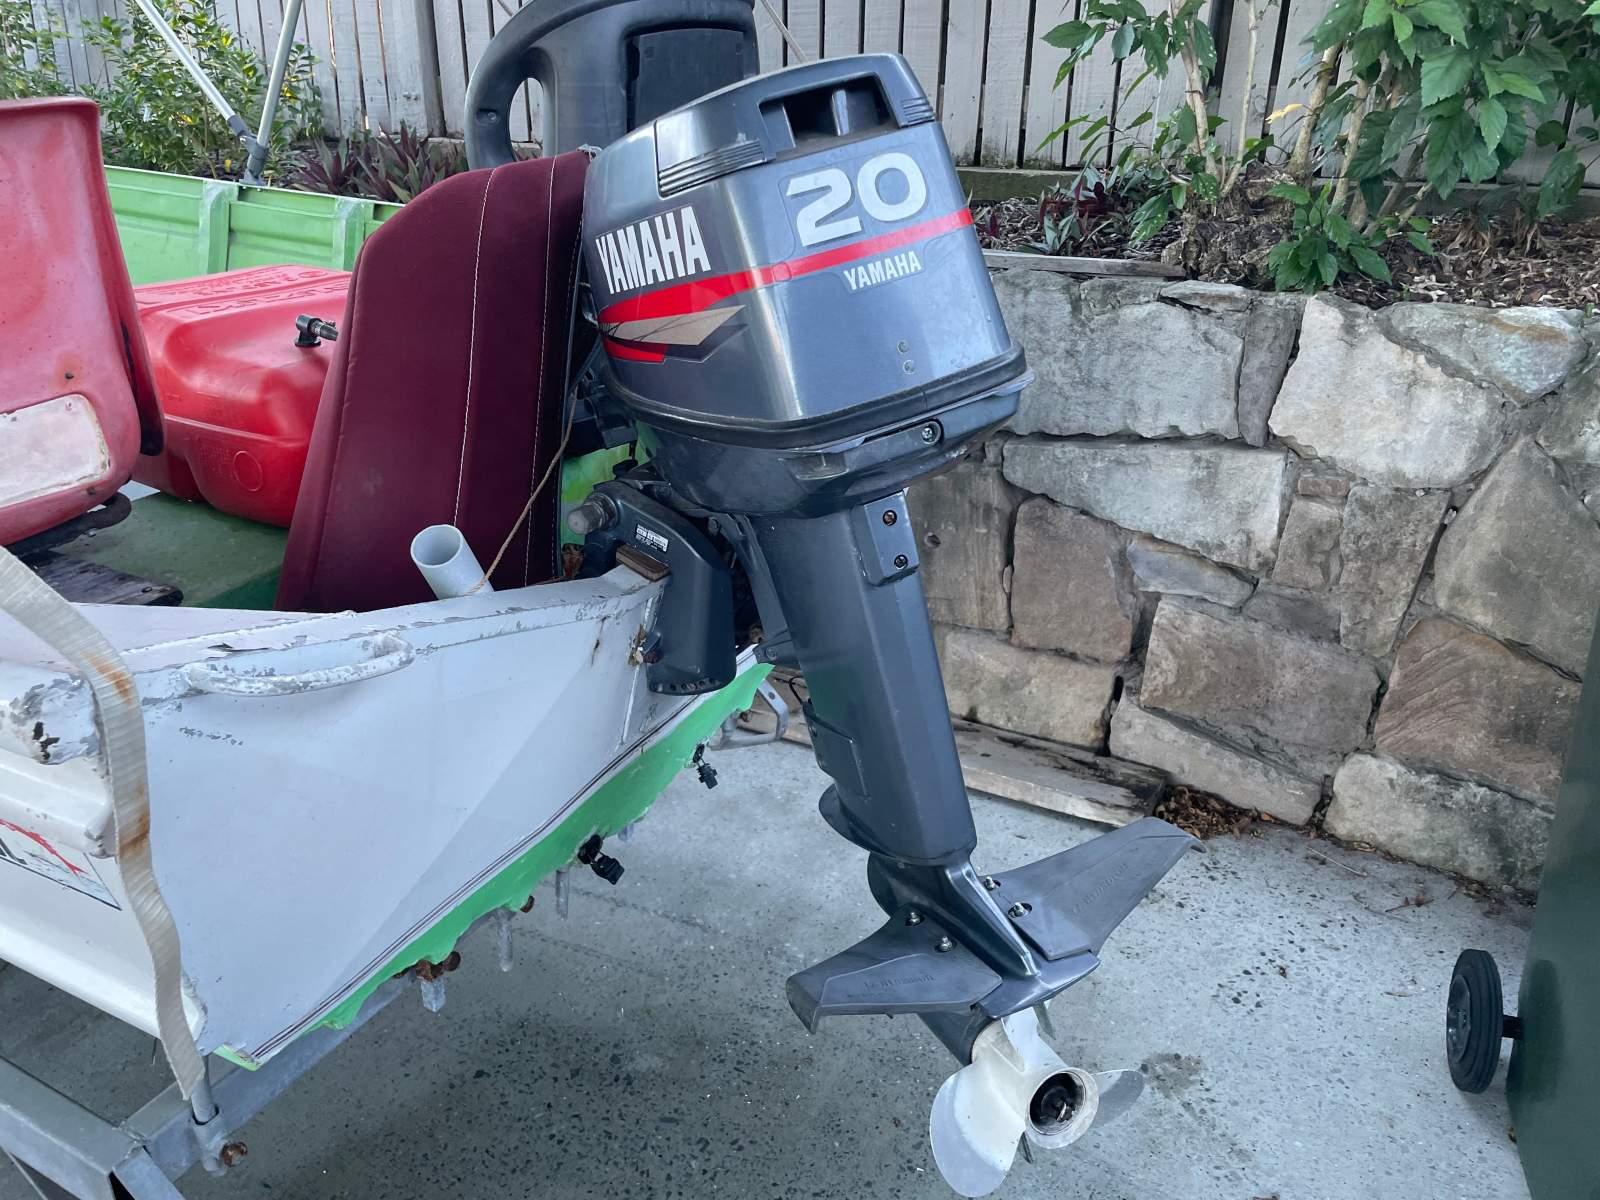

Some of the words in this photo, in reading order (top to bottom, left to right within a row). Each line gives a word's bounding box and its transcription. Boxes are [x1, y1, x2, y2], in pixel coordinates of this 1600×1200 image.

[785, 152, 927, 247] 20
[595, 206, 712, 295] YAMAHA
[843, 251, 922, 291] YAMAHA
